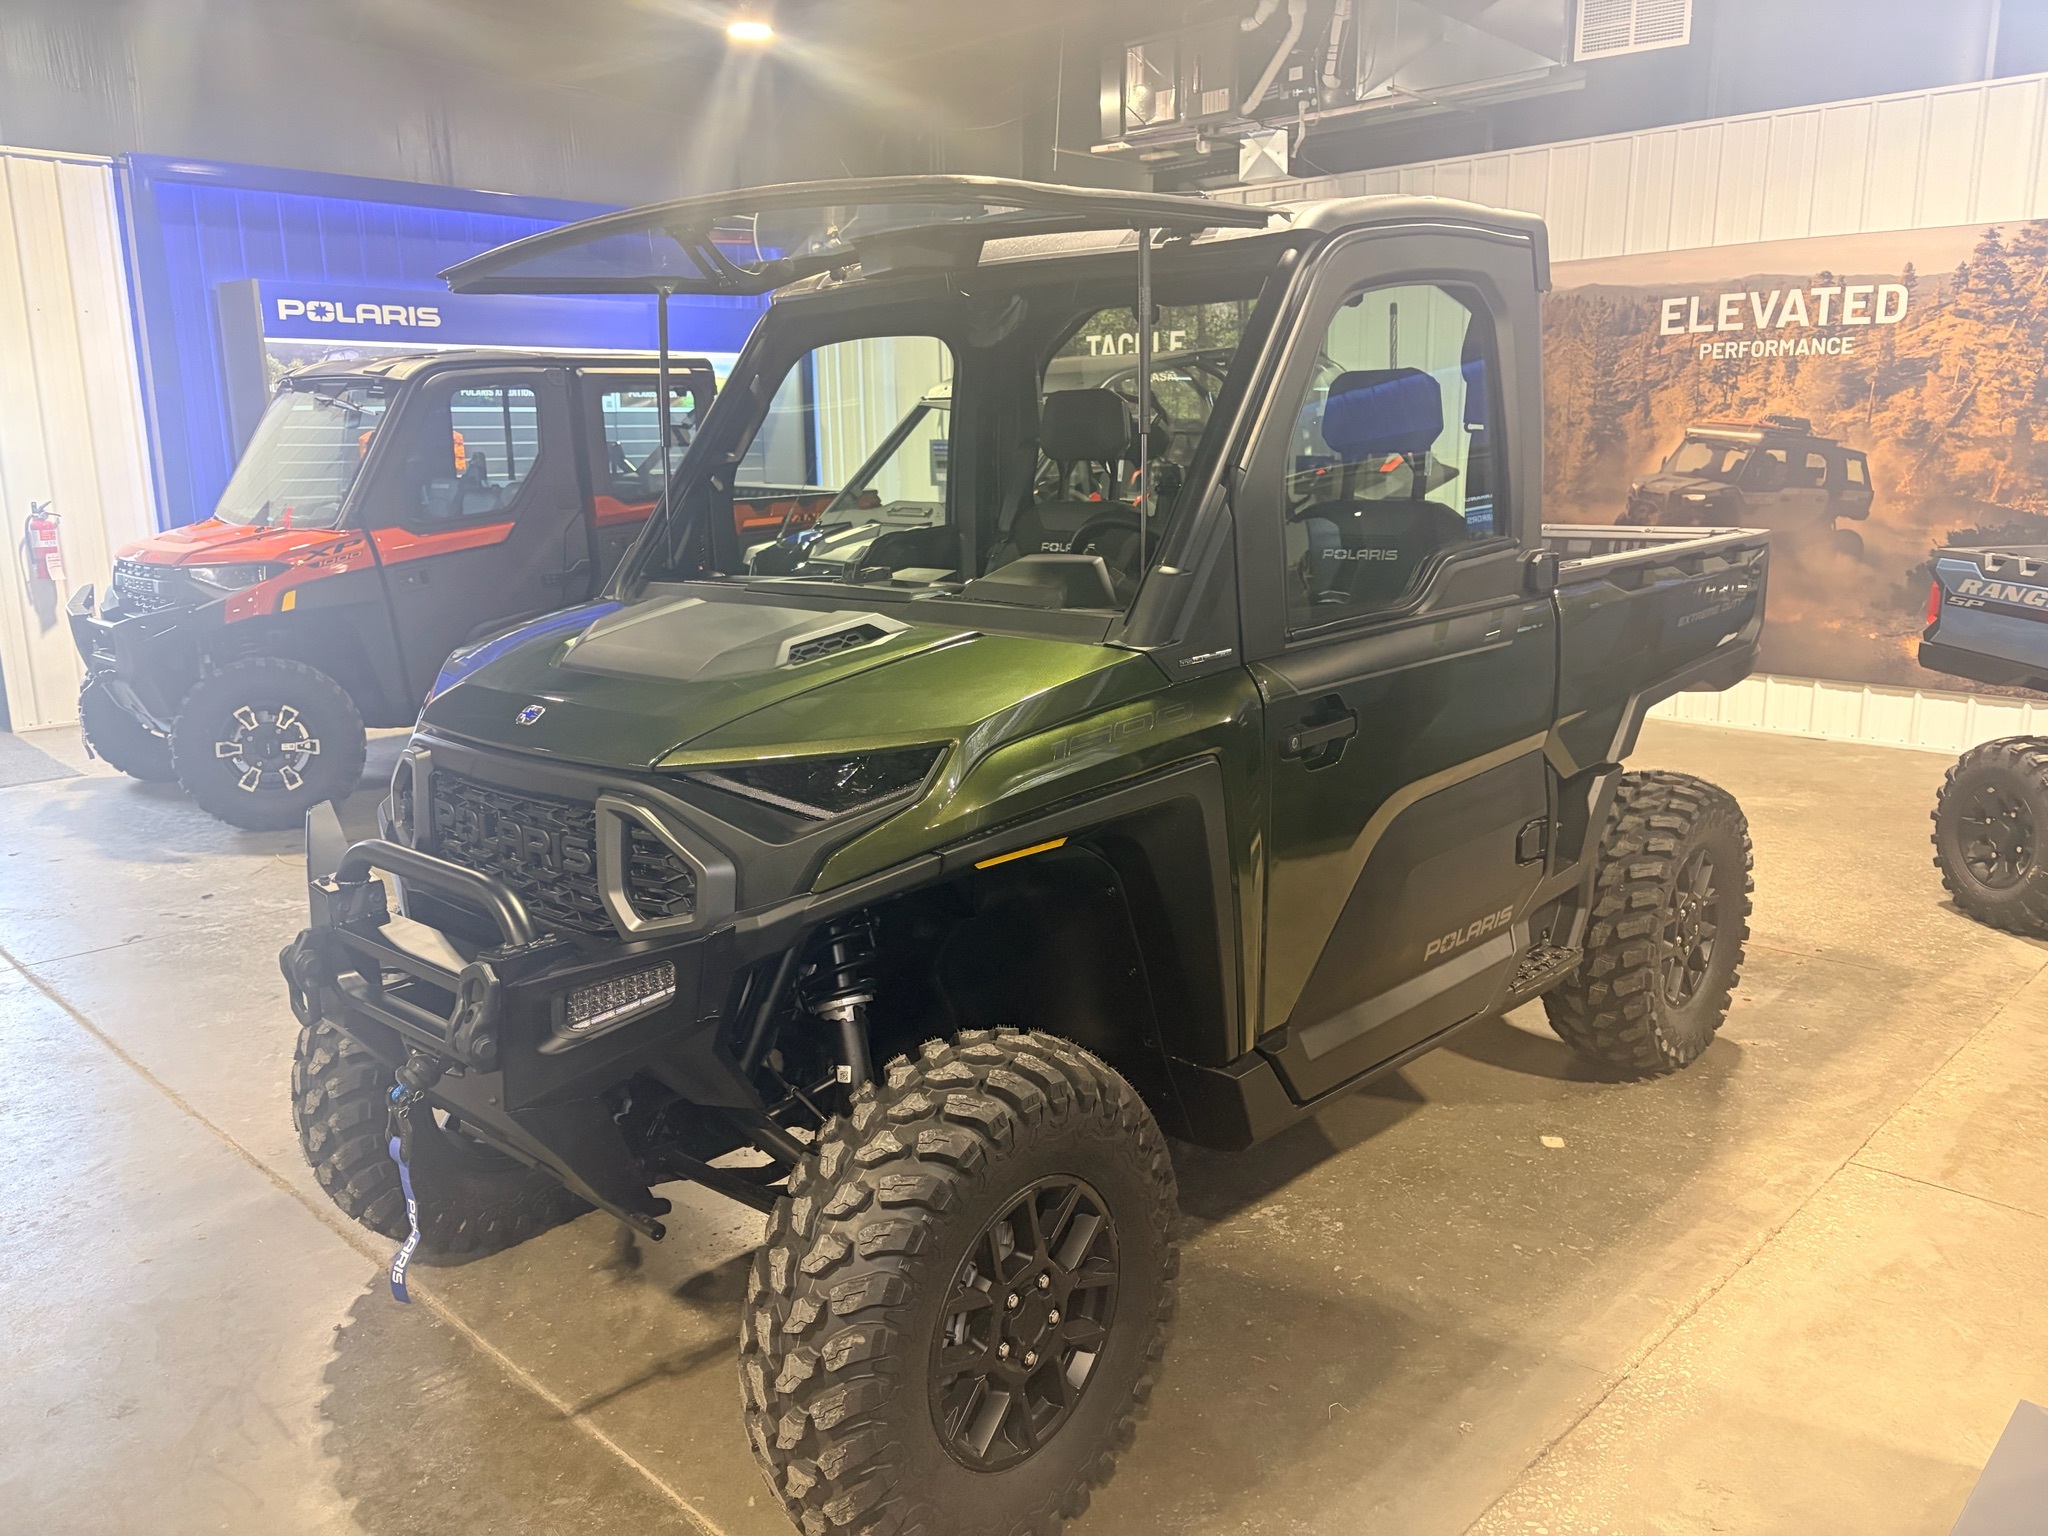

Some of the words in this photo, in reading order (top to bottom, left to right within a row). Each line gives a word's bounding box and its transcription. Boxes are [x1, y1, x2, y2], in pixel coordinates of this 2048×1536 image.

[276, 299, 442, 328] POLARIS
[1659, 283, 1909, 336] ELEVATED
[1699, 336, 1856, 360] PERFORMANCE
[302, 538, 364, 562] XP
[318, 551, 362, 568] 1000
[1322, 548, 1399, 561] POLARIS
[1946, 596, 1986, 607] SP
[1957, 578, 2048, 608] RANG
[434, 798, 593, 875] POLARIS
[1423, 904, 1514, 962] POLARIS
[391, 1198, 420, 1285] POLARIS
